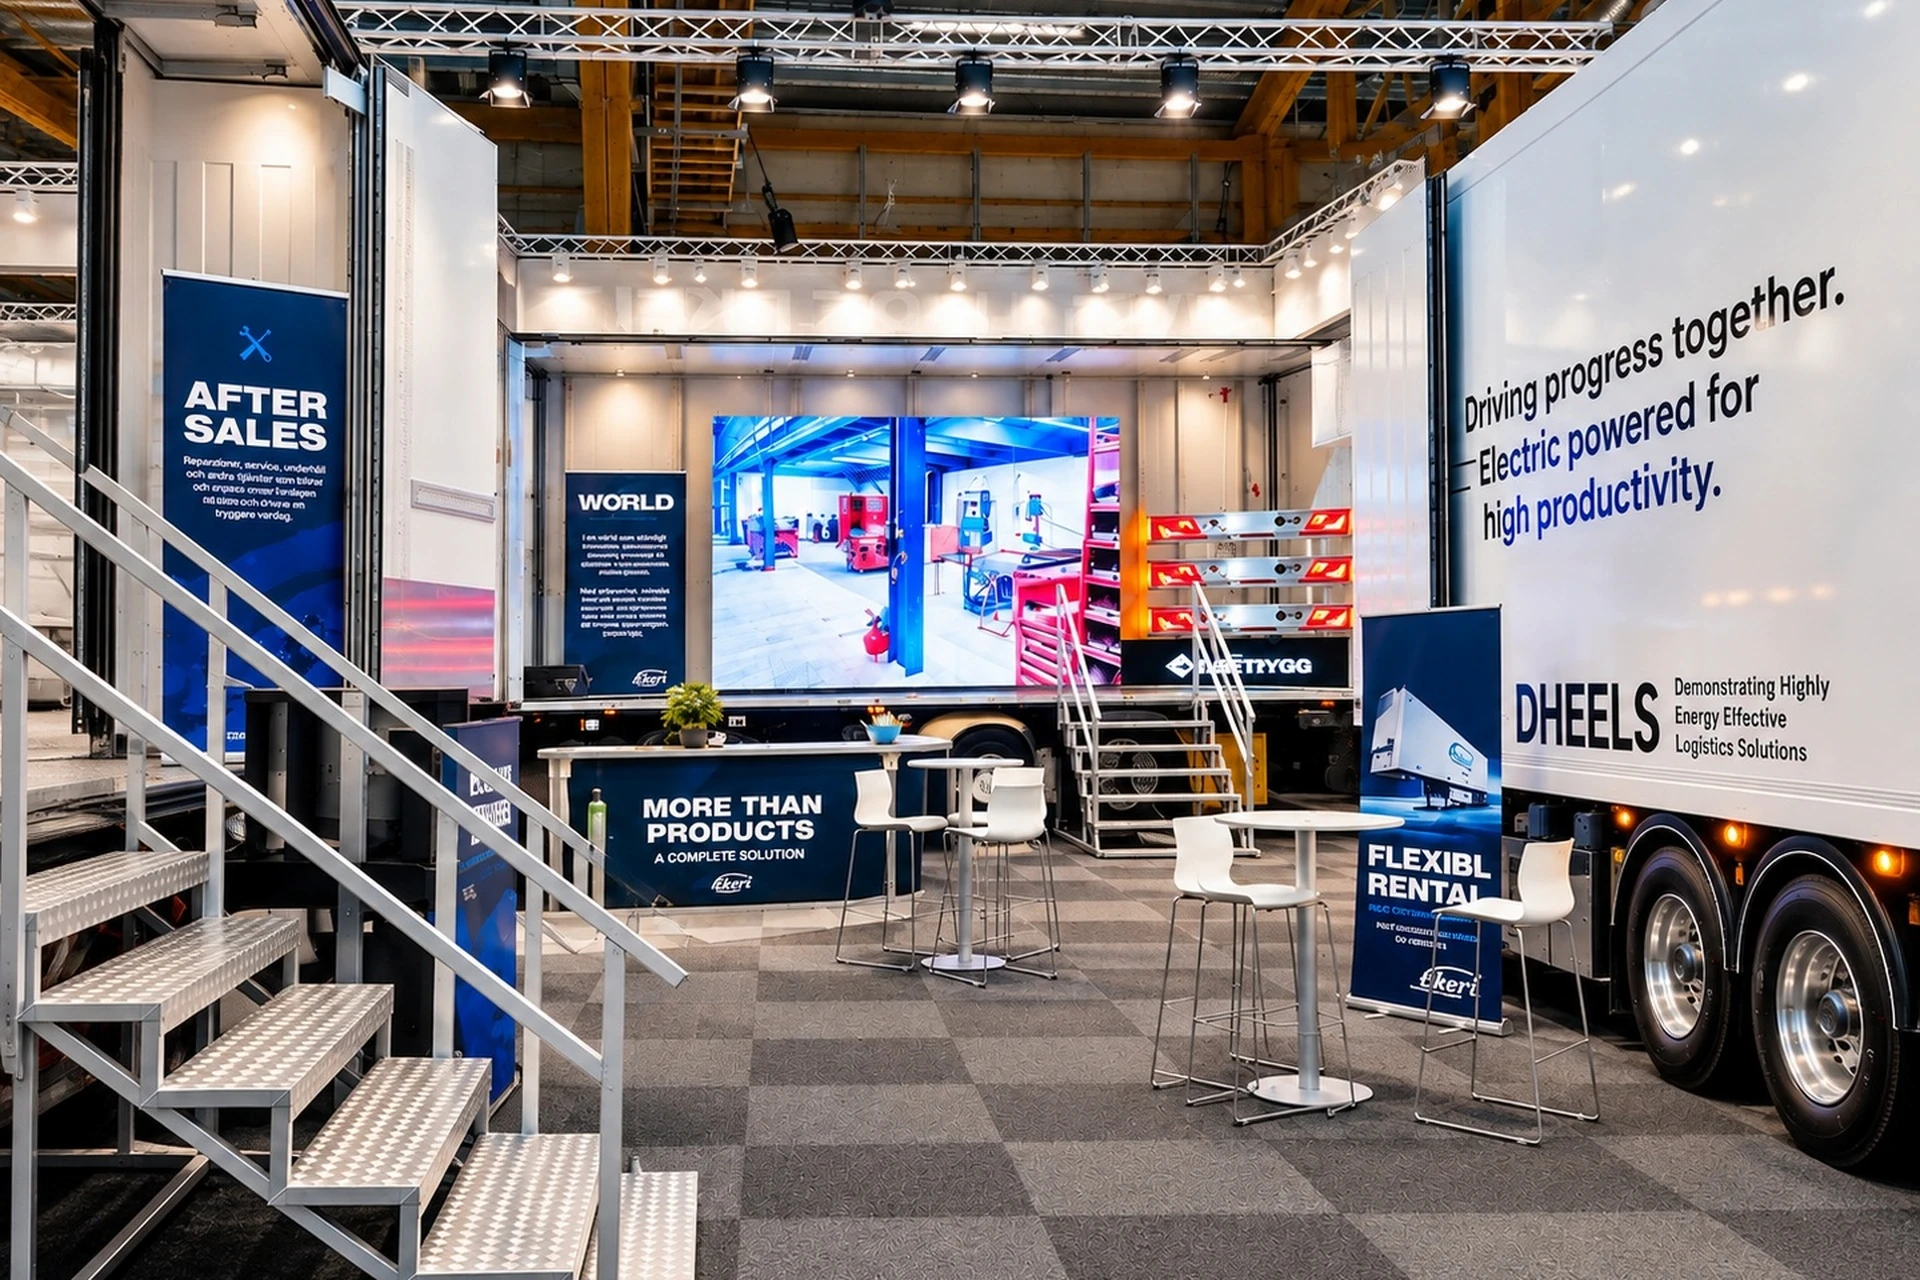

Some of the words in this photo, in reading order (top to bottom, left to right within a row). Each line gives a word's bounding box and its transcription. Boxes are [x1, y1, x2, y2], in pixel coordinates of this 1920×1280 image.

[1465, 378, 1537, 433] Driving
[1545, 332, 1663, 414] progress
[1672, 267, 1844, 358] together.
[184, 380, 327, 419] AFTER
[183, 414, 327, 451] SALES
[1479, 429, 1561, 486] Electric
[1568, 381, 1695, 470] powered
[1707, 372, 1759, 422] for
[578, 493, 674, 511] WORLD
[1483, 495, 1529, 546] high
[1537, 457, 1721, 539] productivity.
[1516, 682, 1660, 754] DHEELS
[1674, 676, 1776, 701] Demonstrating
[1780, 675, 1830, 702] Highly
[1675, 706, 1720, 731] Energy
[1723, 707, 1787, 730] Effective
[1675, 735, 1734, 760] Logistics
[1737, 738, 1808, 763] Solutions
[643, 797, 732, 819] MORE
[741, 795, 822, 816] THAN
[647, 820, 815, 844] PRODUCTS
[654, 853, 665, 864] A
[668, 851, 736, 863] COMPLETE
[740, 848, 805, 861] SOLUTION
[1368, 844, 1492, 880] FLEXIBL
